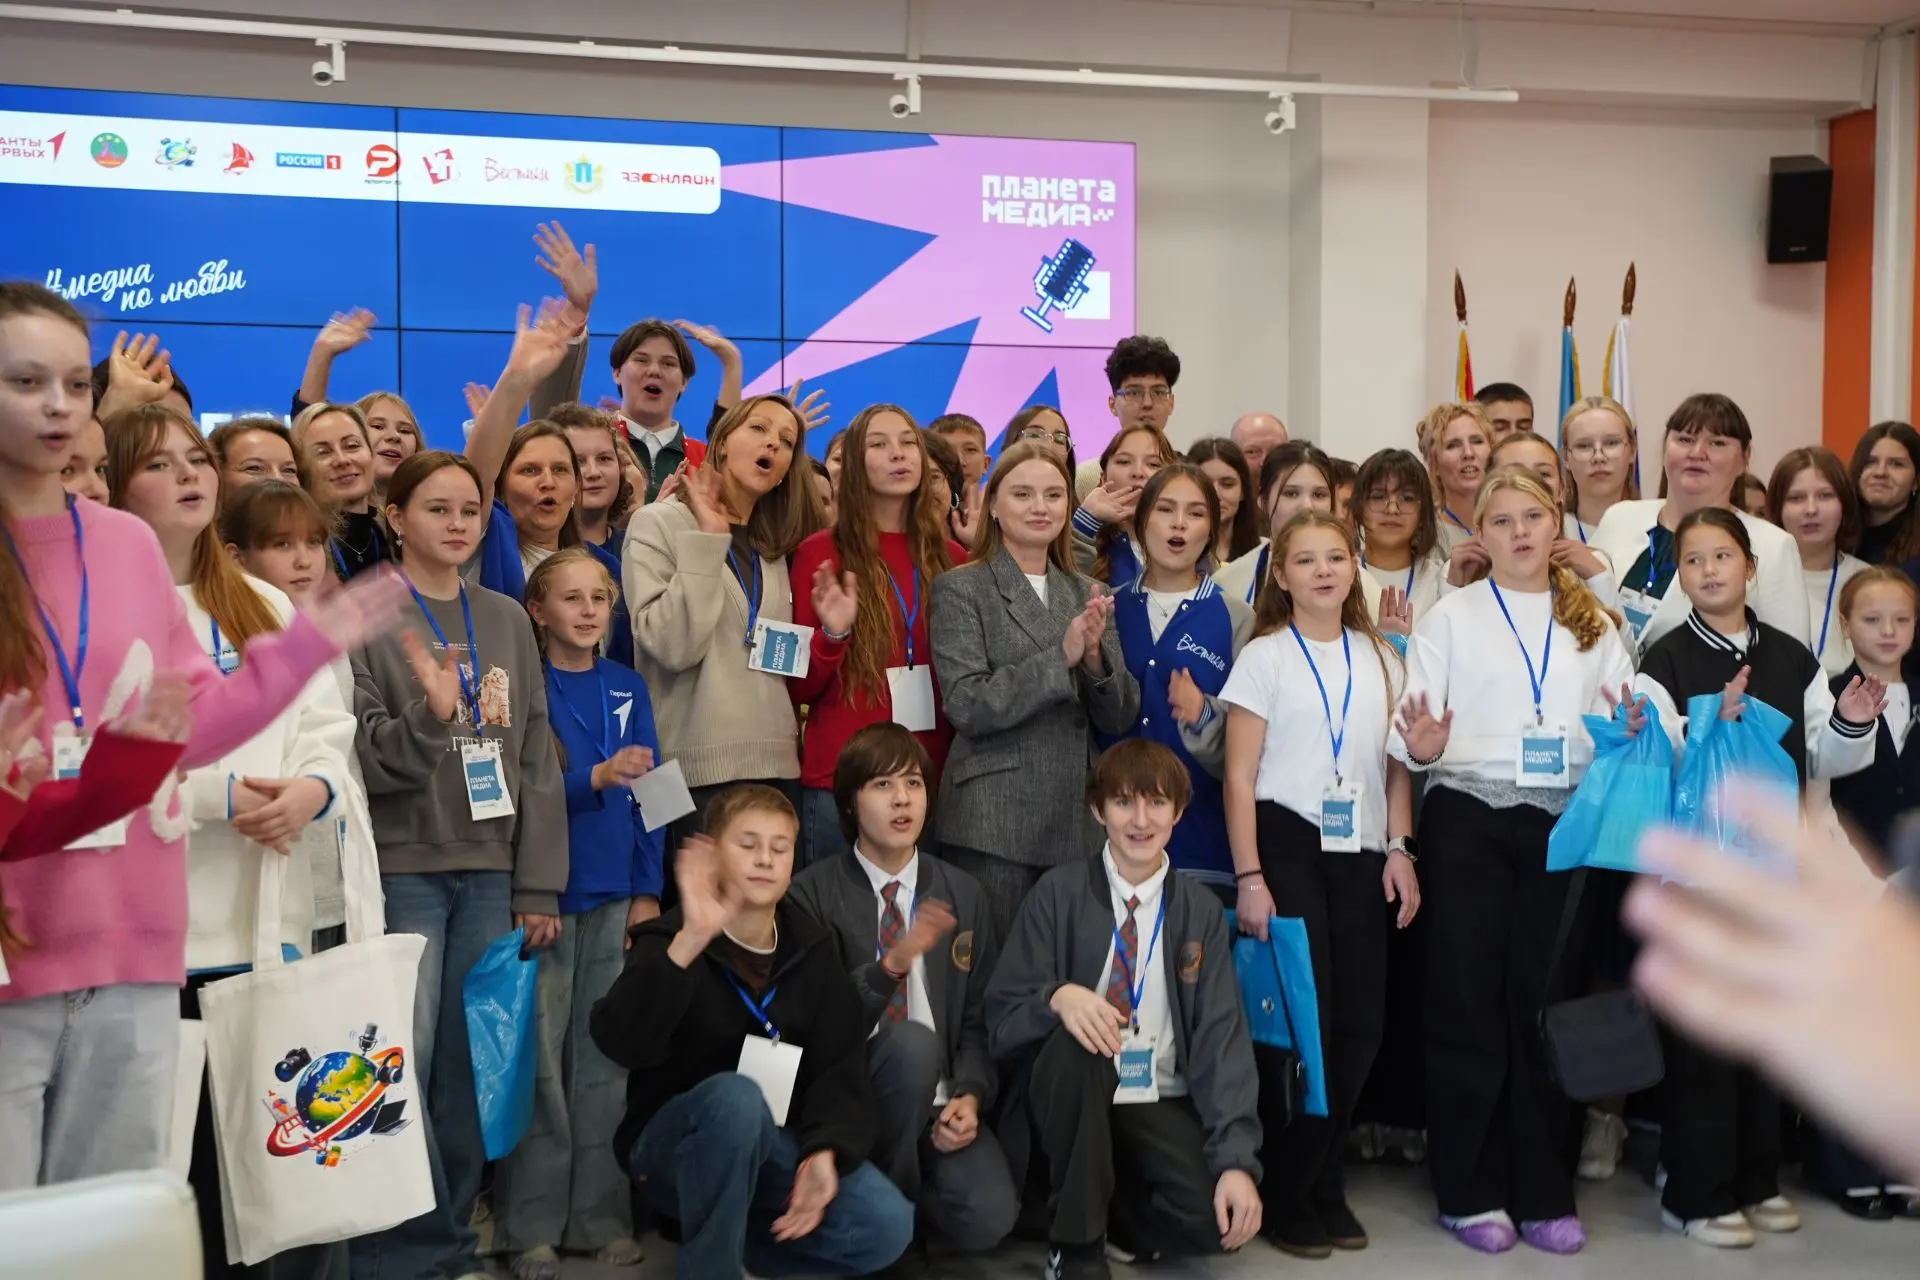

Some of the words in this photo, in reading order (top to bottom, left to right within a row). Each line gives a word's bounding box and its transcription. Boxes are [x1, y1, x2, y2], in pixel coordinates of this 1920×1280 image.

[0, 147, 45, 158] РВЫХ
[280, 154, 323, 166] РОССИЯ
[982, 199, 1091, 227] МЕДИА
[120, 287, 154, 312] по
[160, 259, 246, 304] любви
[772, 634, 783, 668] ПЛАНЕТА
[1524, 750, 1559, 758] ПЛАНЕТА
[470, 776, 496, 784] ПЛАНЕТА
[472, 782, 492, 790] МЕДИА
